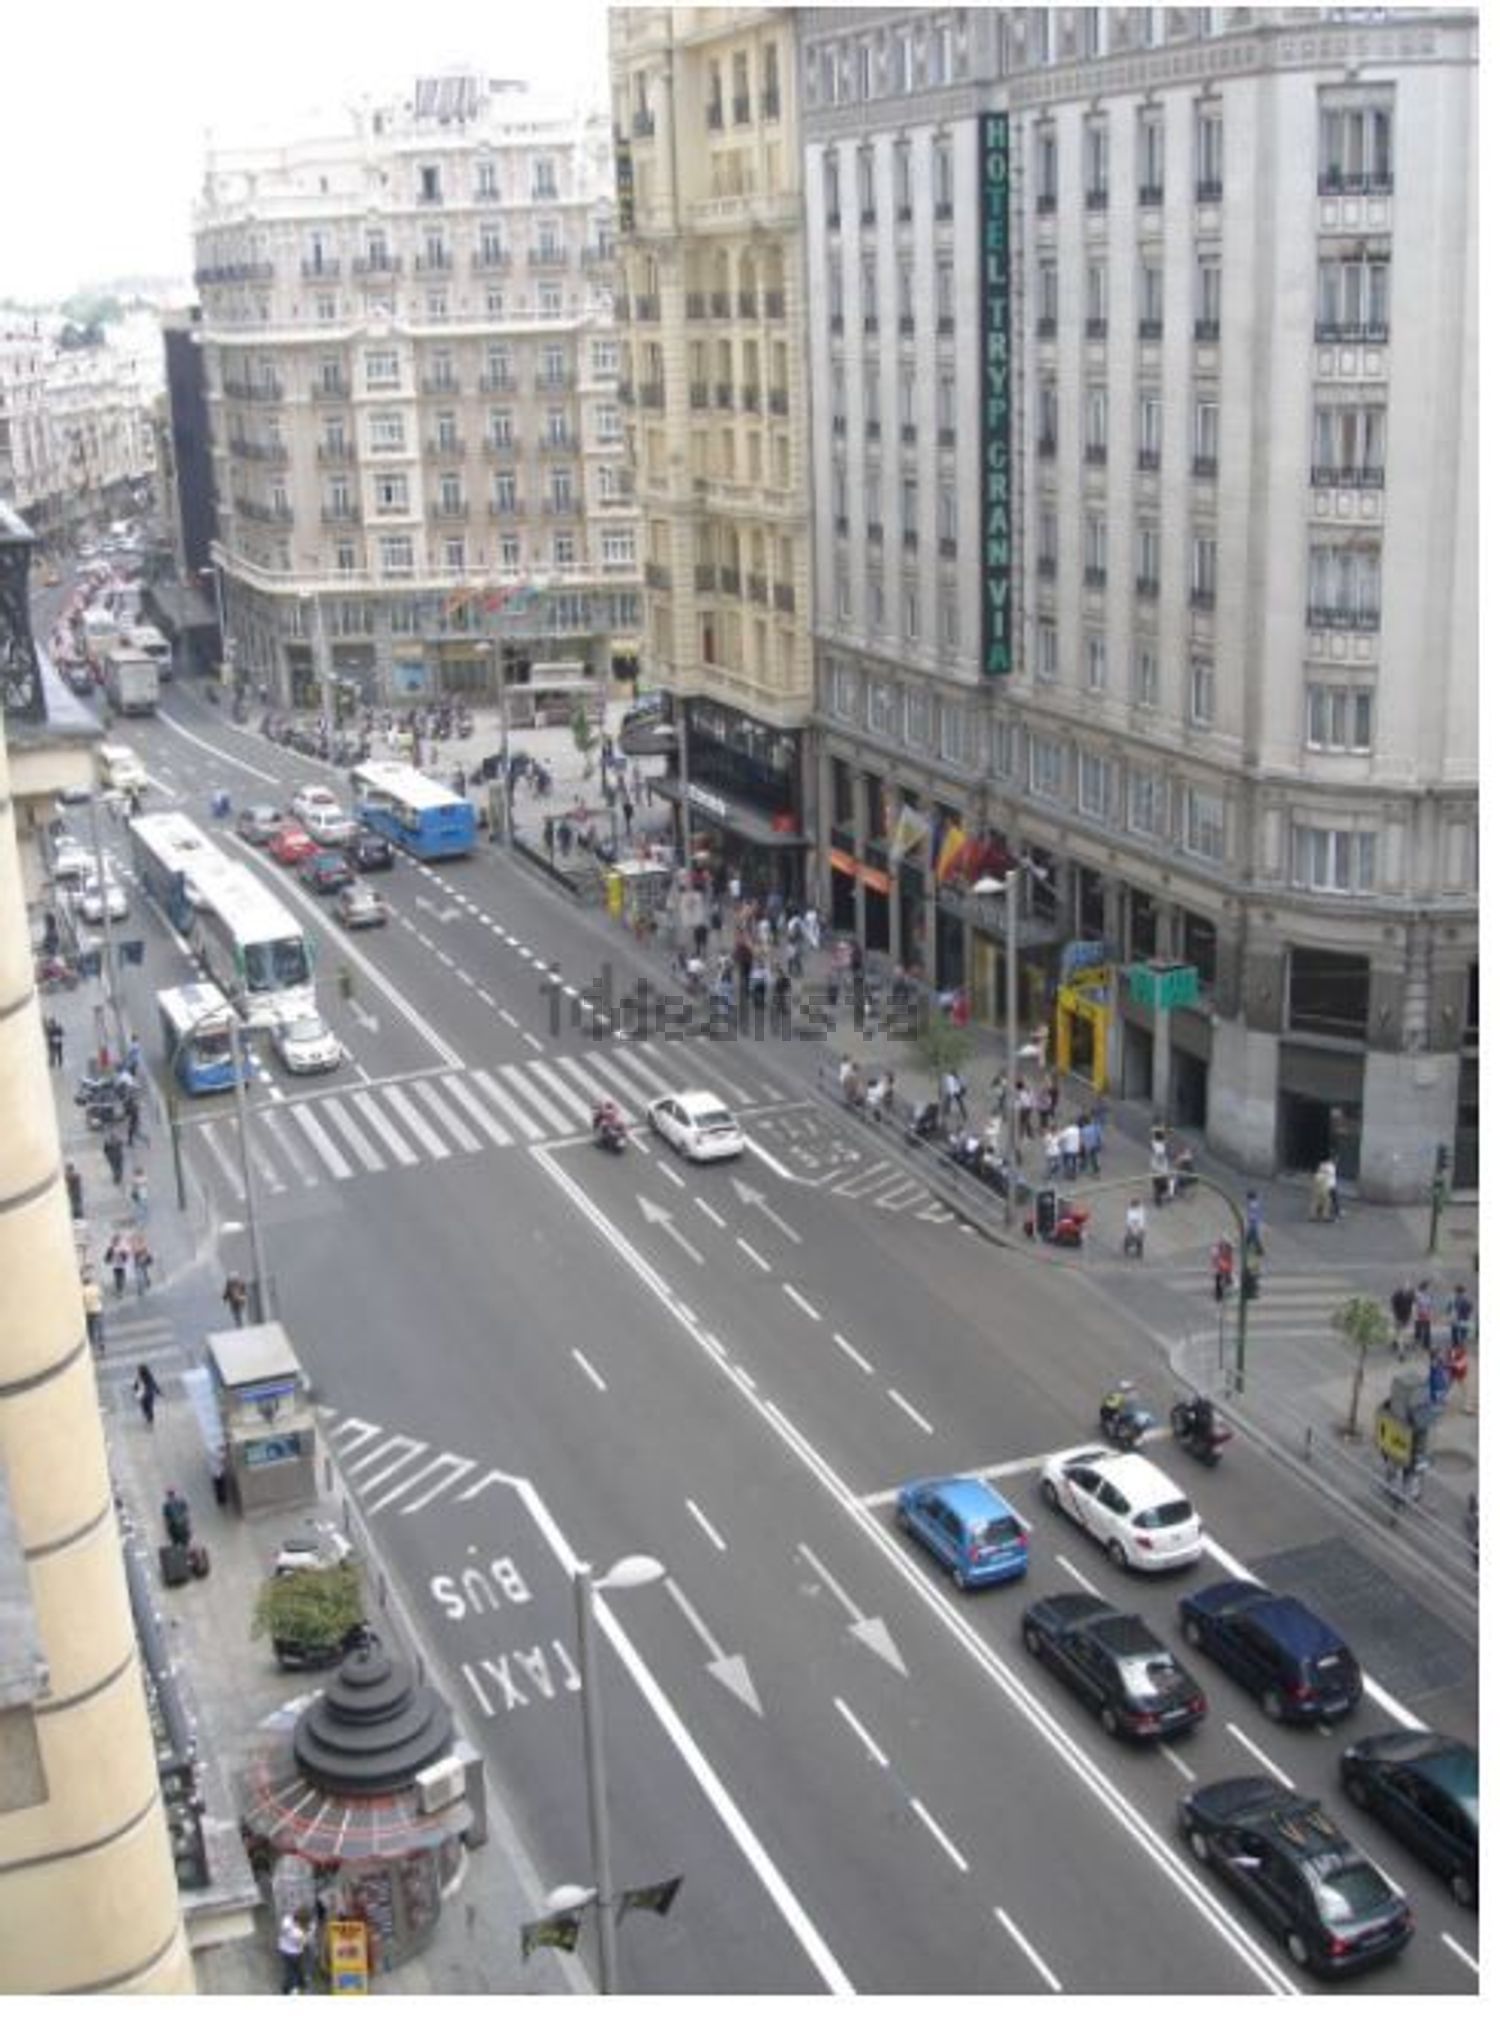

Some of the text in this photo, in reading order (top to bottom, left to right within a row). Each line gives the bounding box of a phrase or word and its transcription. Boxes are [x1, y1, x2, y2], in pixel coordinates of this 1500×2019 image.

[986, 118, 1010, 672] HOTEL TRYP GRAN VIA
[430, 1555, 534, 1621] BUS
[461, 1638, 583, 1717] TAXI
